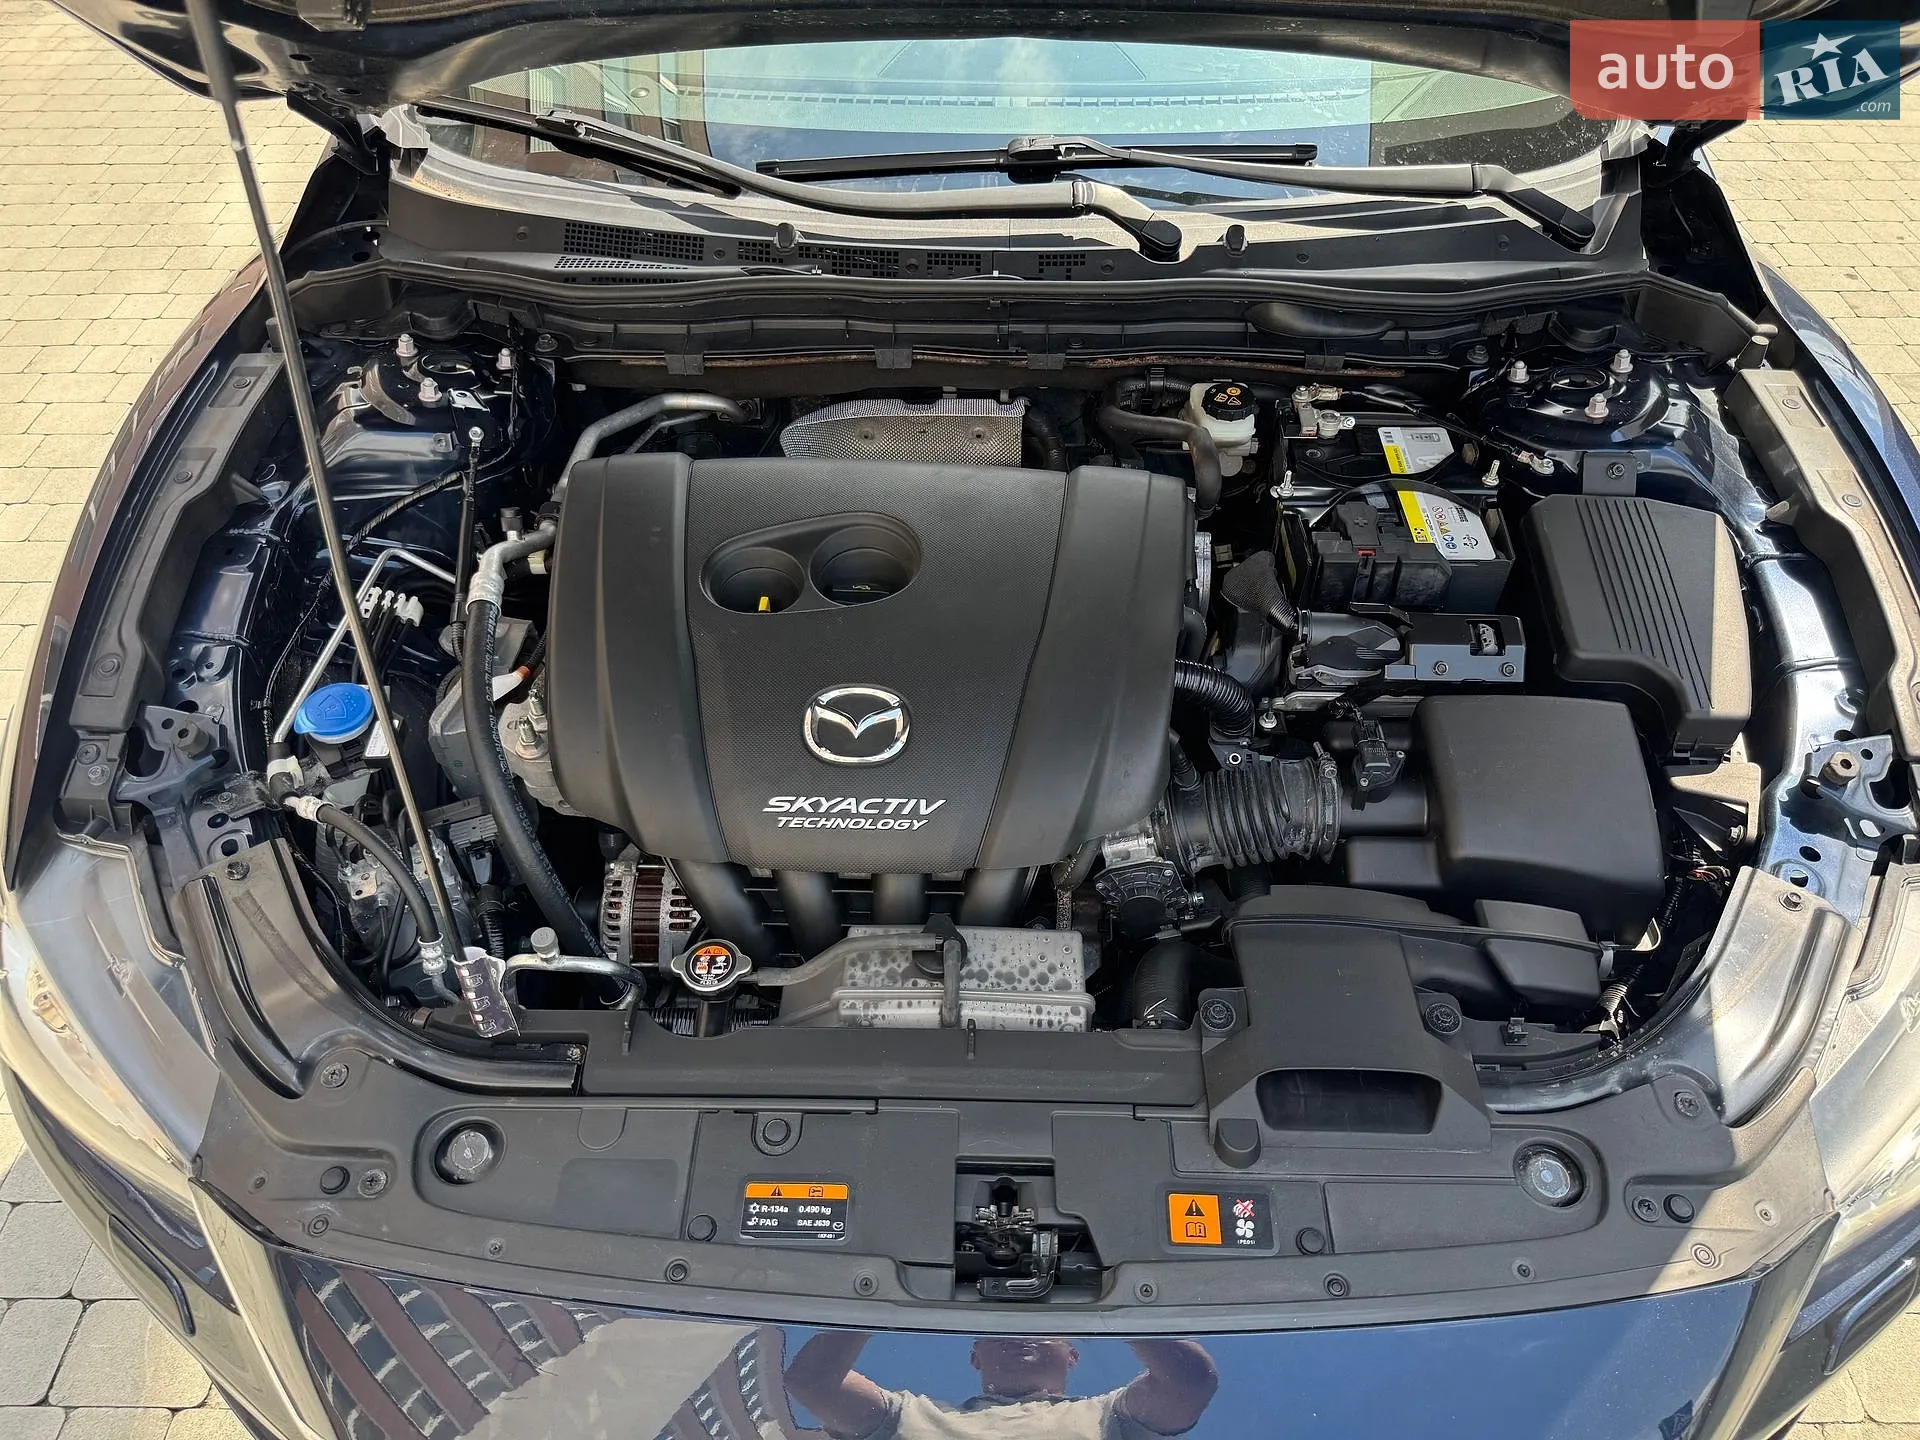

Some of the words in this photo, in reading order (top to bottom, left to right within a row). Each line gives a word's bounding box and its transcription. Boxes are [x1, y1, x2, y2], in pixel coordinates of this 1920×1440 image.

[762, 796, 947, 815] SKYACTIV
[777, 816, 929, 830] TECHNOLOGY
[761, 1205, 789, 1213] R-134a
[799, 1205, 820, 1213] 0.490
[821, 1205, 832, 1215] kg
[813, 1219, 831, 1227] J639
